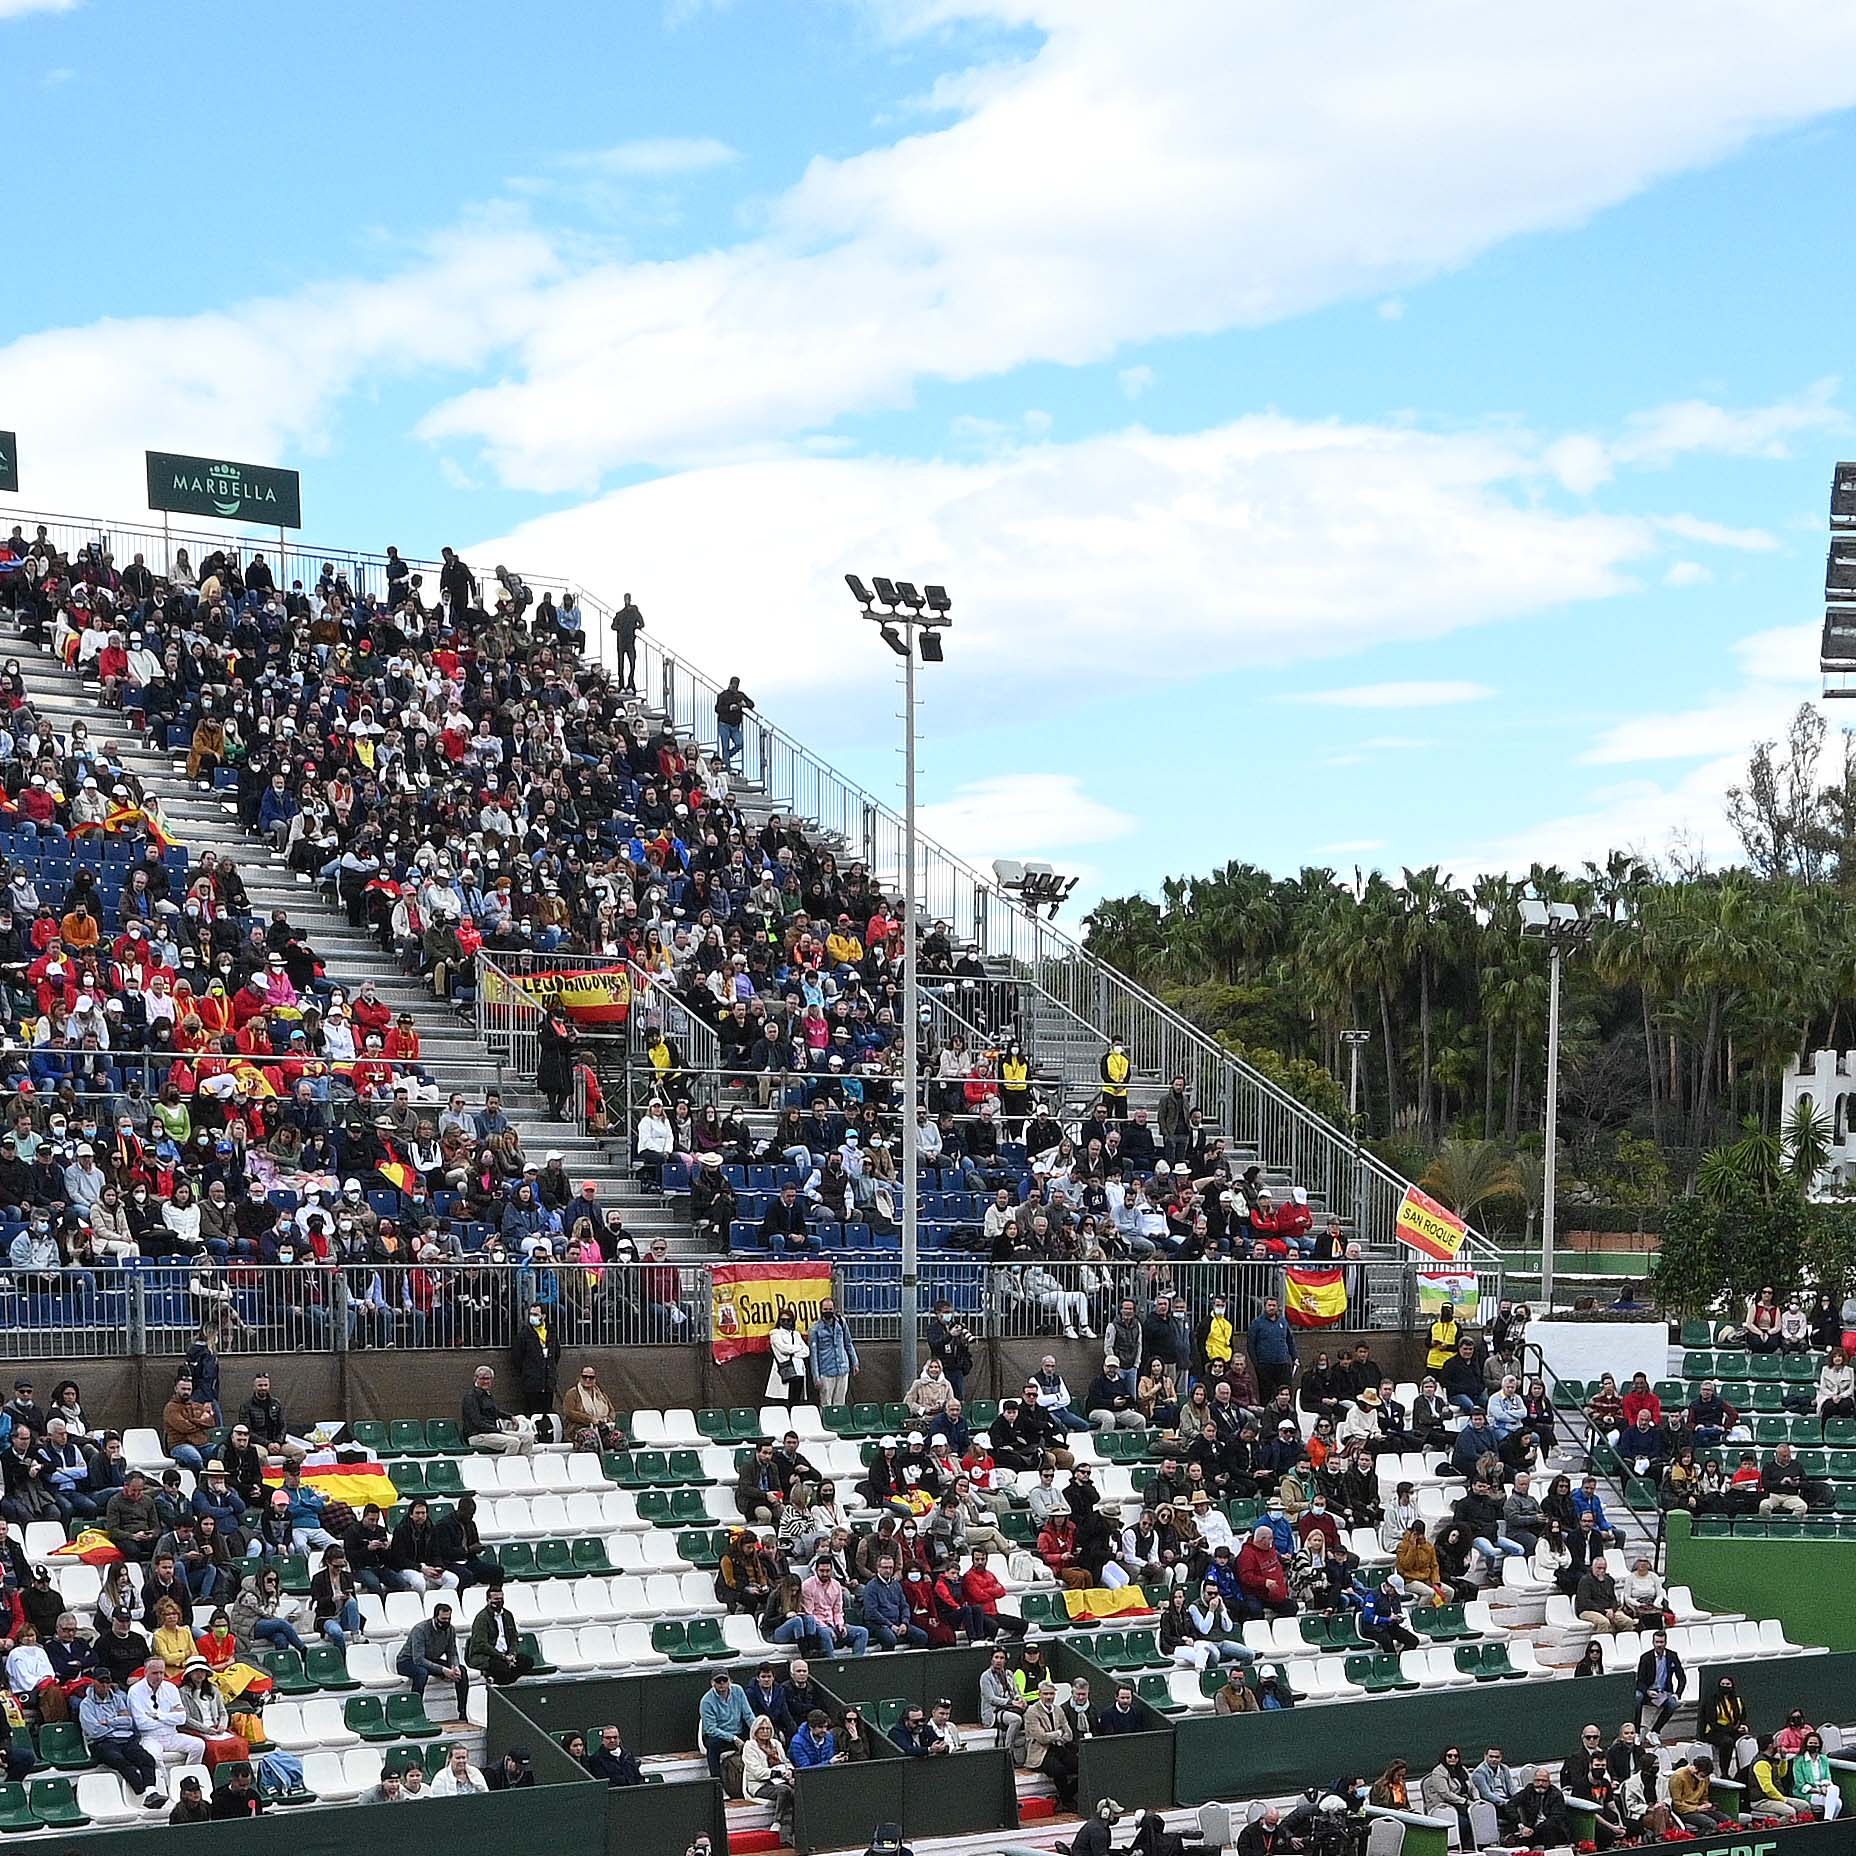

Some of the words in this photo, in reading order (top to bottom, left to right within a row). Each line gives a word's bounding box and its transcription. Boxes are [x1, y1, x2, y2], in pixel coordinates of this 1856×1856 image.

[173, 474, 276, 502] MARBELLA
[1403, 1207, 1424, 1230] SAN
[1423, 1220, 1457, 1248] ROQUE
[739, 1294, 775, 1325] San
[775, 1293, 820, 1335] Roqu
